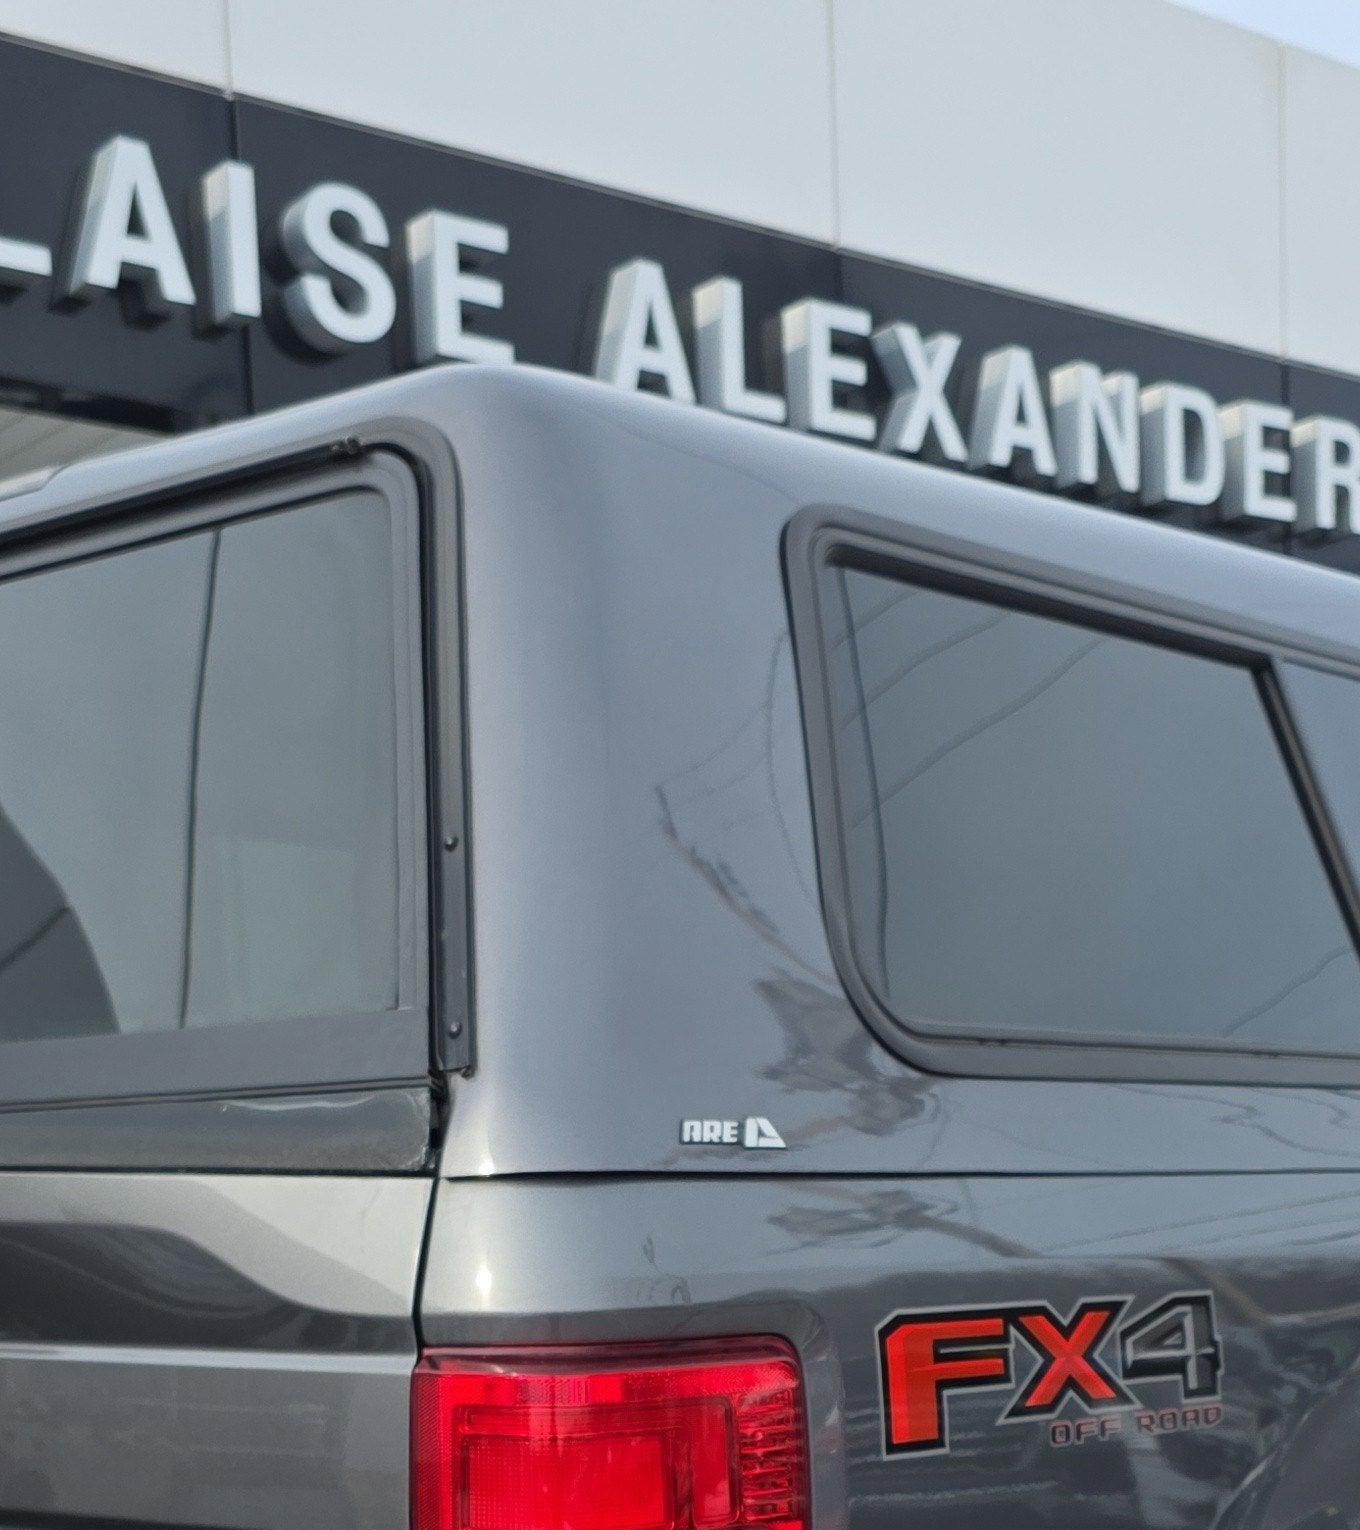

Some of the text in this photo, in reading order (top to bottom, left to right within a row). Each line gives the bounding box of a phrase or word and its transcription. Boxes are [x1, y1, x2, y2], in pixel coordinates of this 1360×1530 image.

[874, 1290, 1225, 1461] FX4
[1051, 1402, 1223, 1448] OFF ROAD
